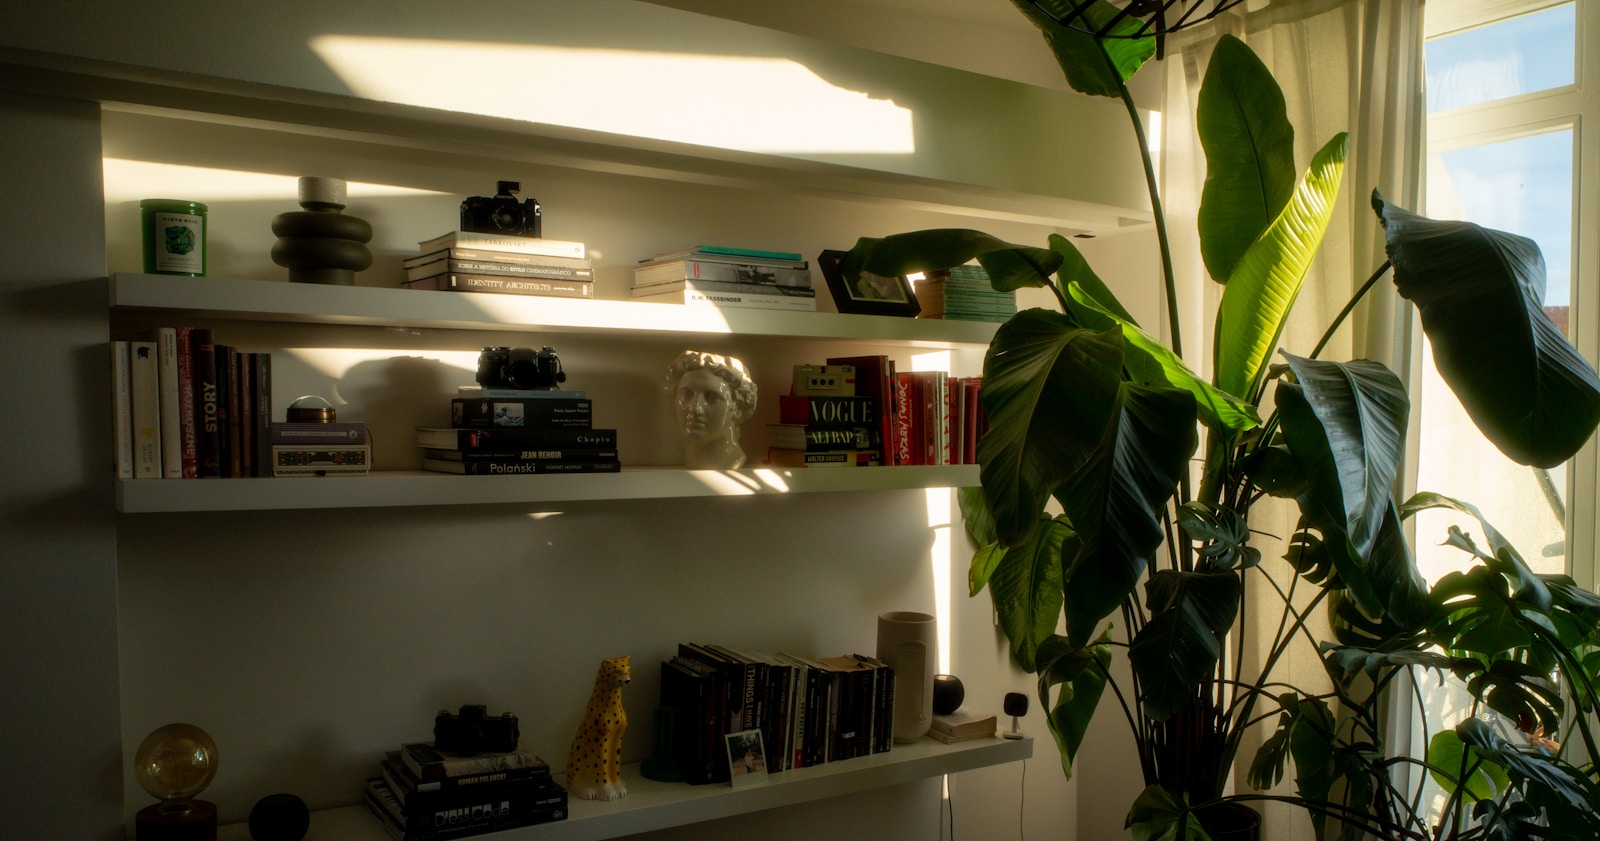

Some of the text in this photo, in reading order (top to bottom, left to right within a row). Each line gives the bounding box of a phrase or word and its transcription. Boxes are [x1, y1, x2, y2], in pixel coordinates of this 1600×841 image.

[467, 278, 504, 288] IDENTITY
[506, 280, 552, 291] ARCHITECTS
[706, 295, 742, 303] FASSBINDER
[202, 381, 217, 434] STORY
[810, 399, 873, 423] VOGUE
[898, 380, 910, 460] JONAS MEKAS
[577, 435, 611, 445] Chopin
[520, 450, 562, 460] JEAN RENOIR
[490, 462, 536, 473] Polański
[745, 666, 756, 704] THINGS
[457, 776, 479, 785] ROMAN
